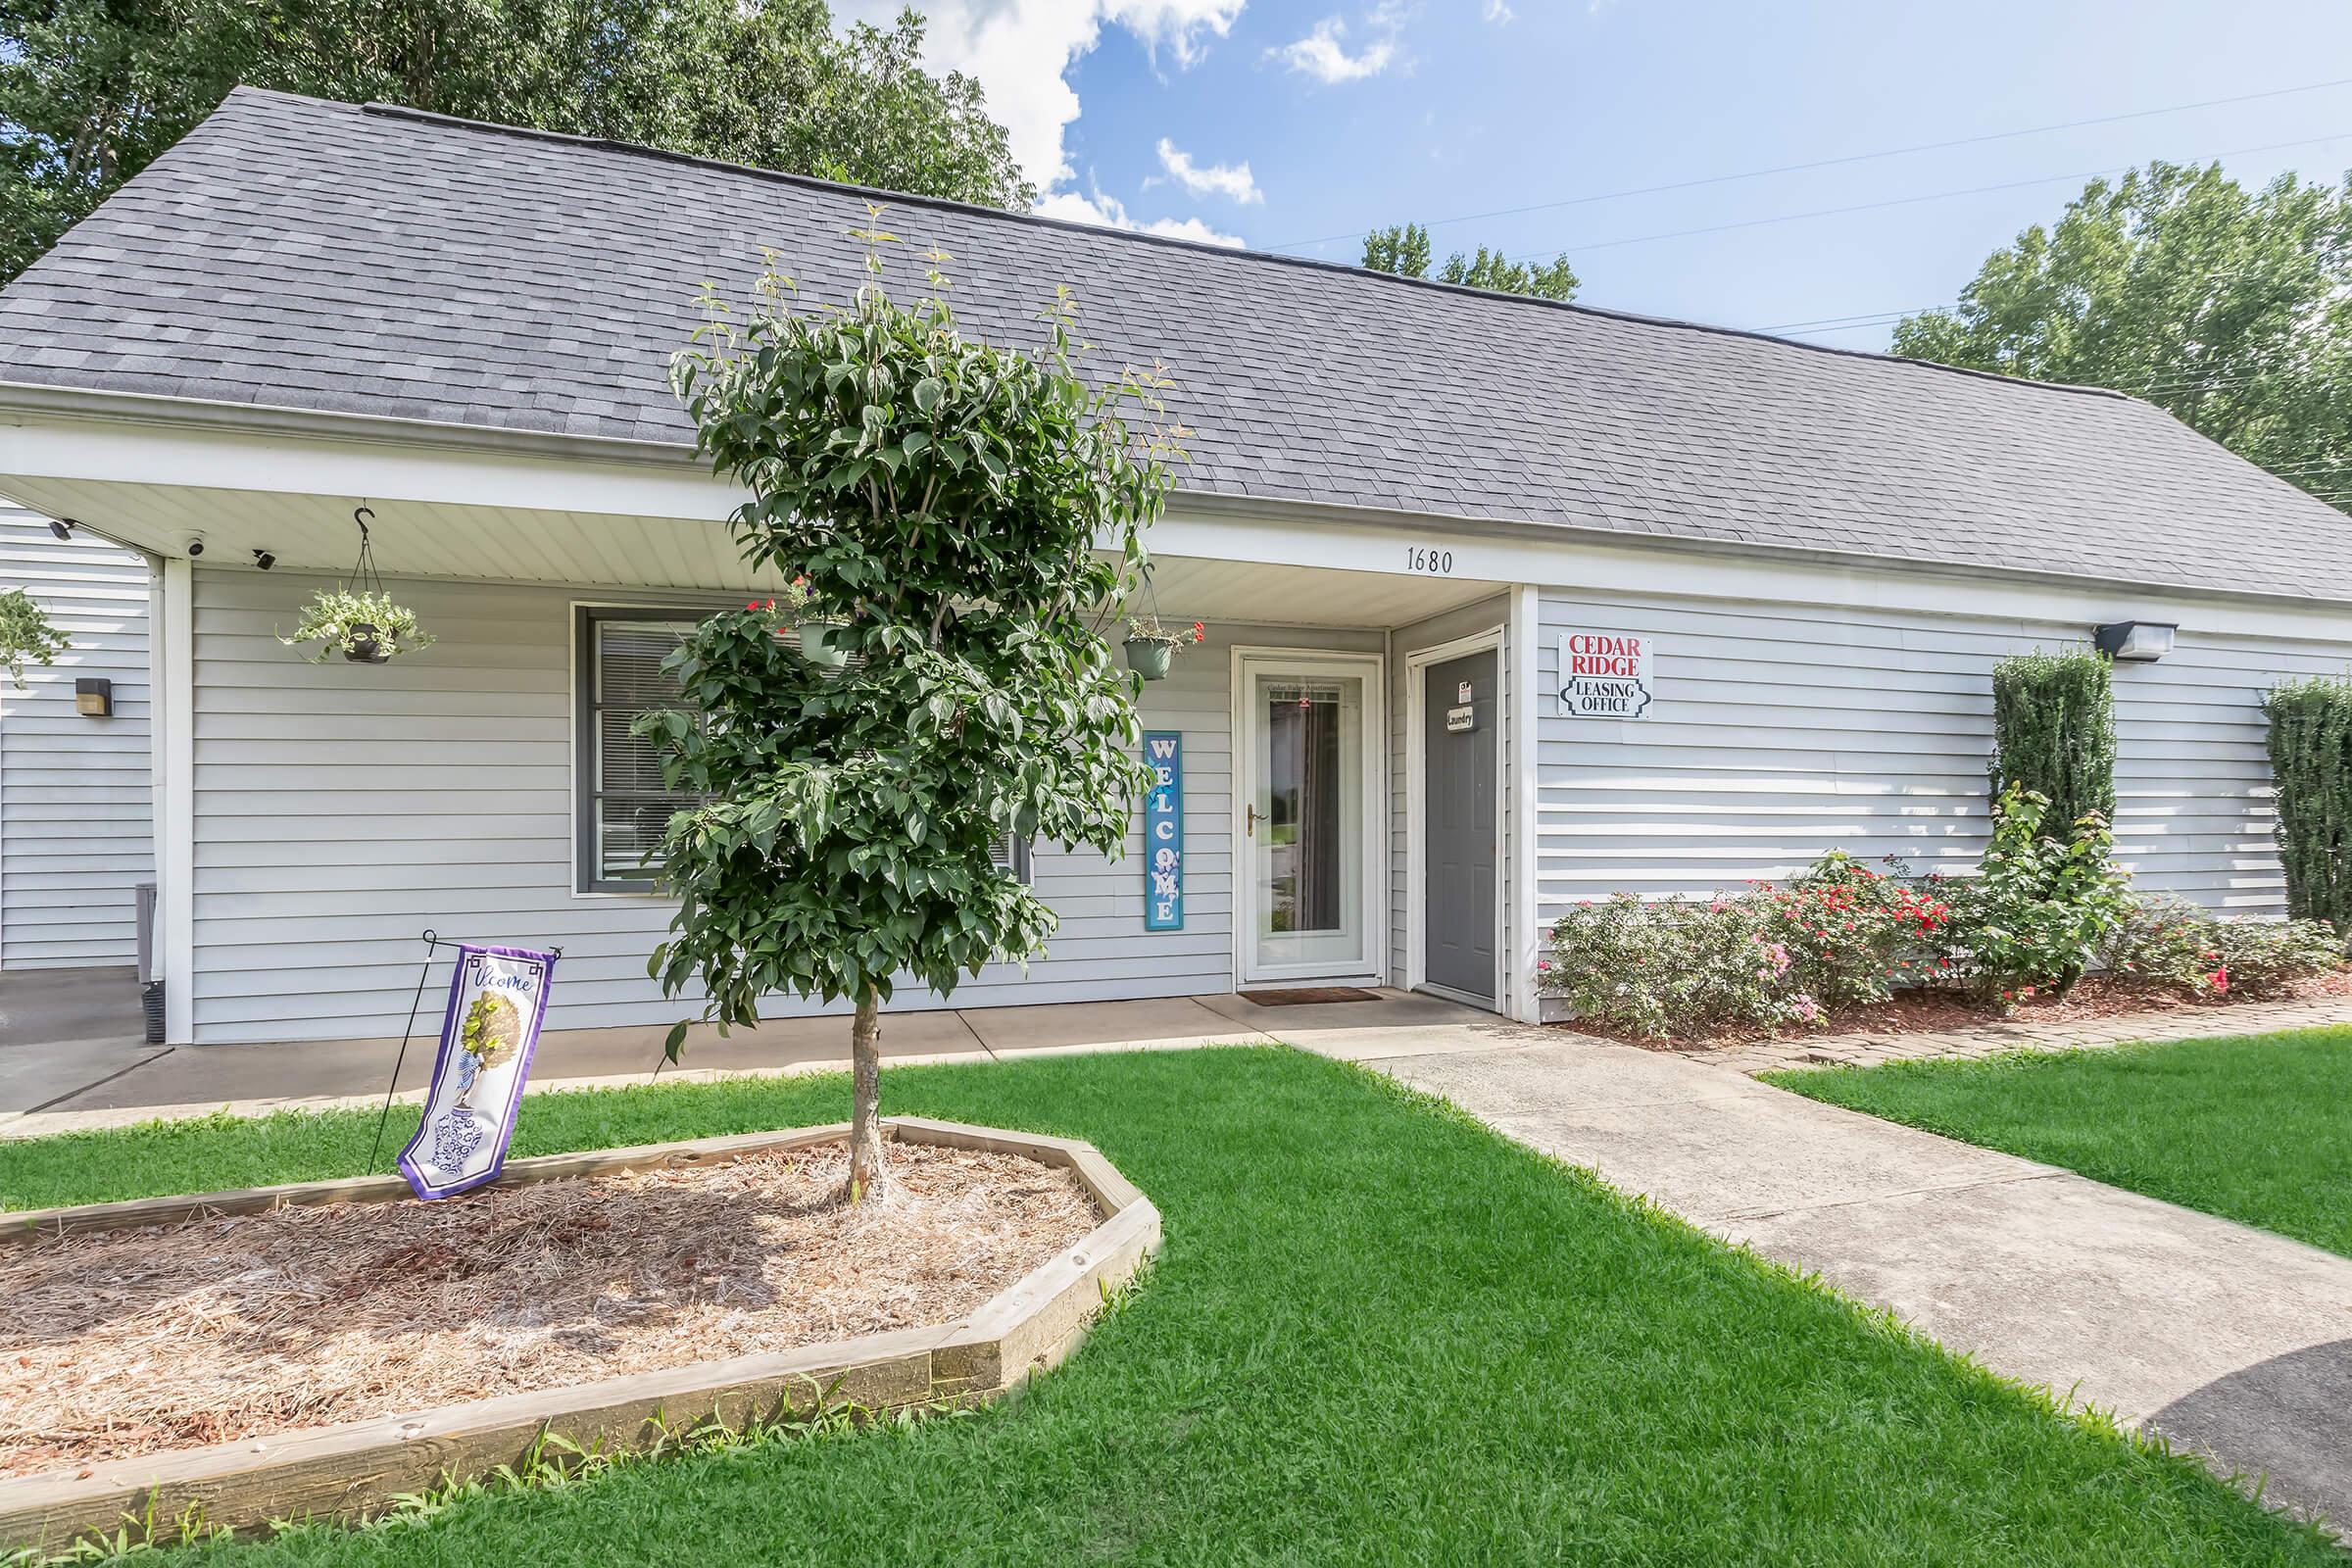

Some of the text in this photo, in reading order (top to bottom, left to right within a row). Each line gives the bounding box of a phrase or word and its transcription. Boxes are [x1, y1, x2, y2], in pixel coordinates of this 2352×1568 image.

[1407, 547, 1452, 573] 1680
[1569, 634, 1641, 657] CEDAR
[1571, 655, 1640, 676] RIDGE
[1576, 681, 1635, 698] LEASING
[1581, 696, 1630, 712] OFFICE
[1447, 712, 1473, 726] Laundry
[1151, 740, 1177, 921] WELCOME
